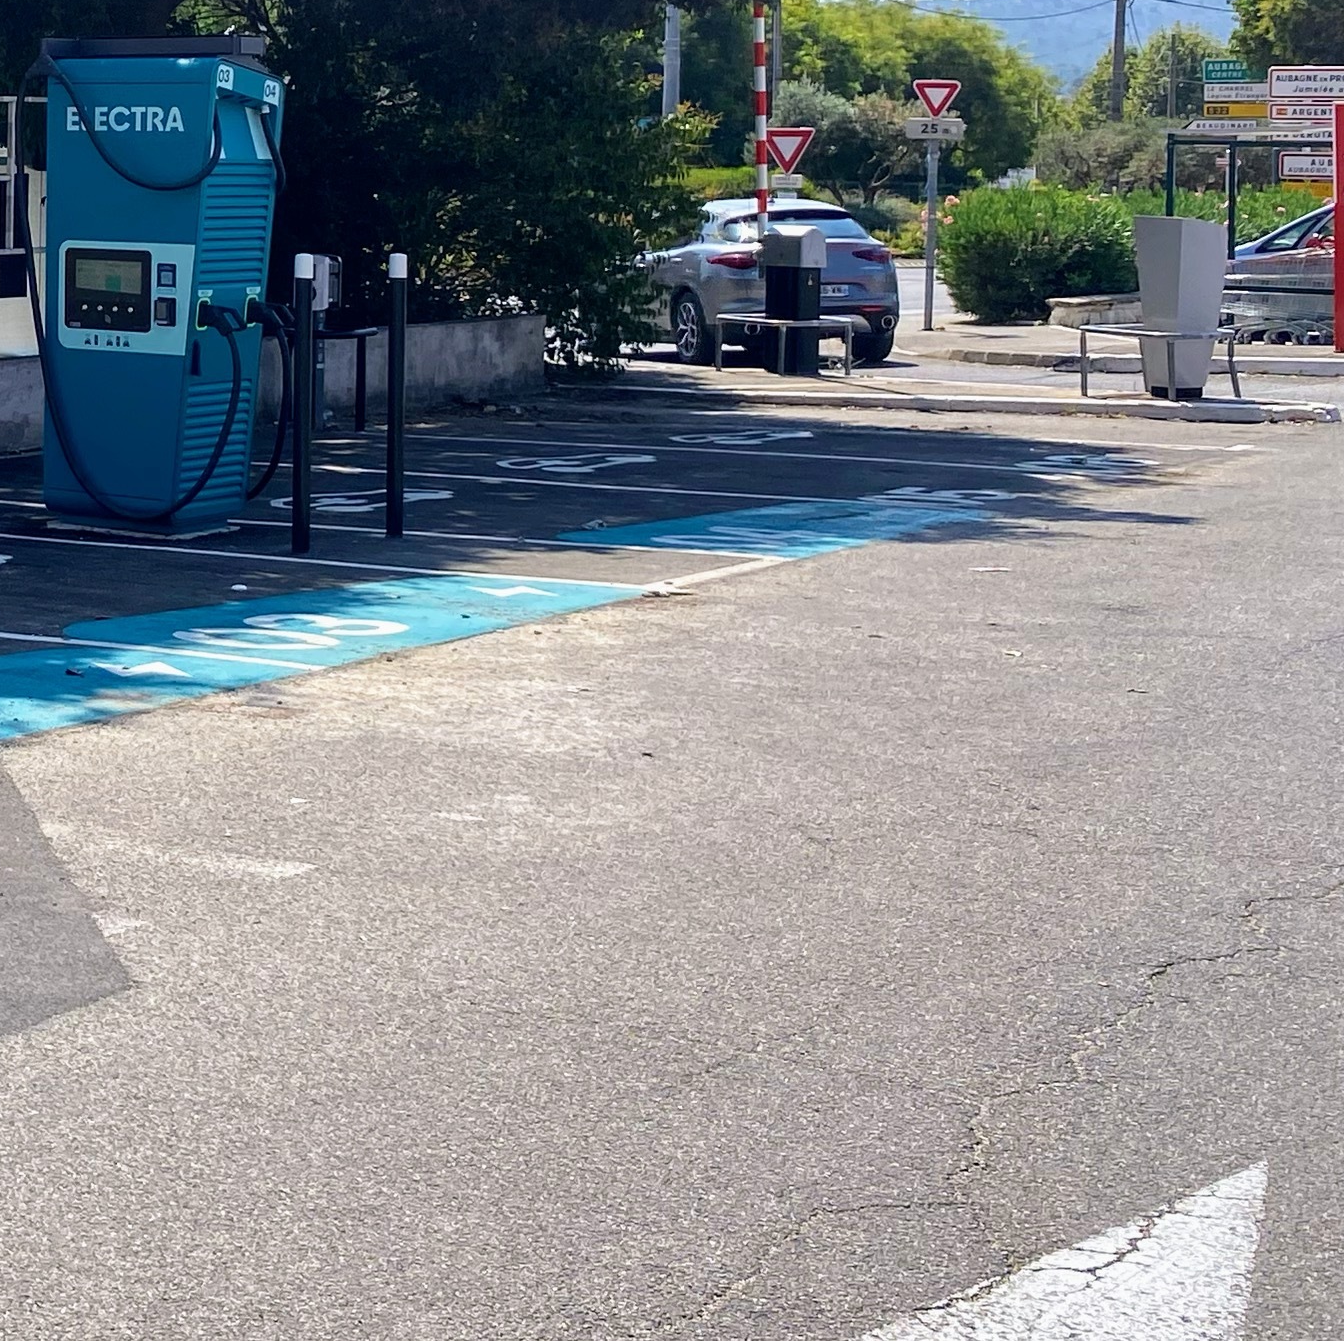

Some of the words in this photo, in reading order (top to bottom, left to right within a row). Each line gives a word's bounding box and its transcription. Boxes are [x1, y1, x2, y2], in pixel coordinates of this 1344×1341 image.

[218, 69, 230, 83] 03
[1275, 74, 1318, 82] AUBAGNE
[1330, 74, 1344, 82] PR
[265, 84, 276, 97] 04
[67, 106, 184, 132] EECTRA
[921, 124, 939, 134] 25
[172, 613, 411, 650] 03
